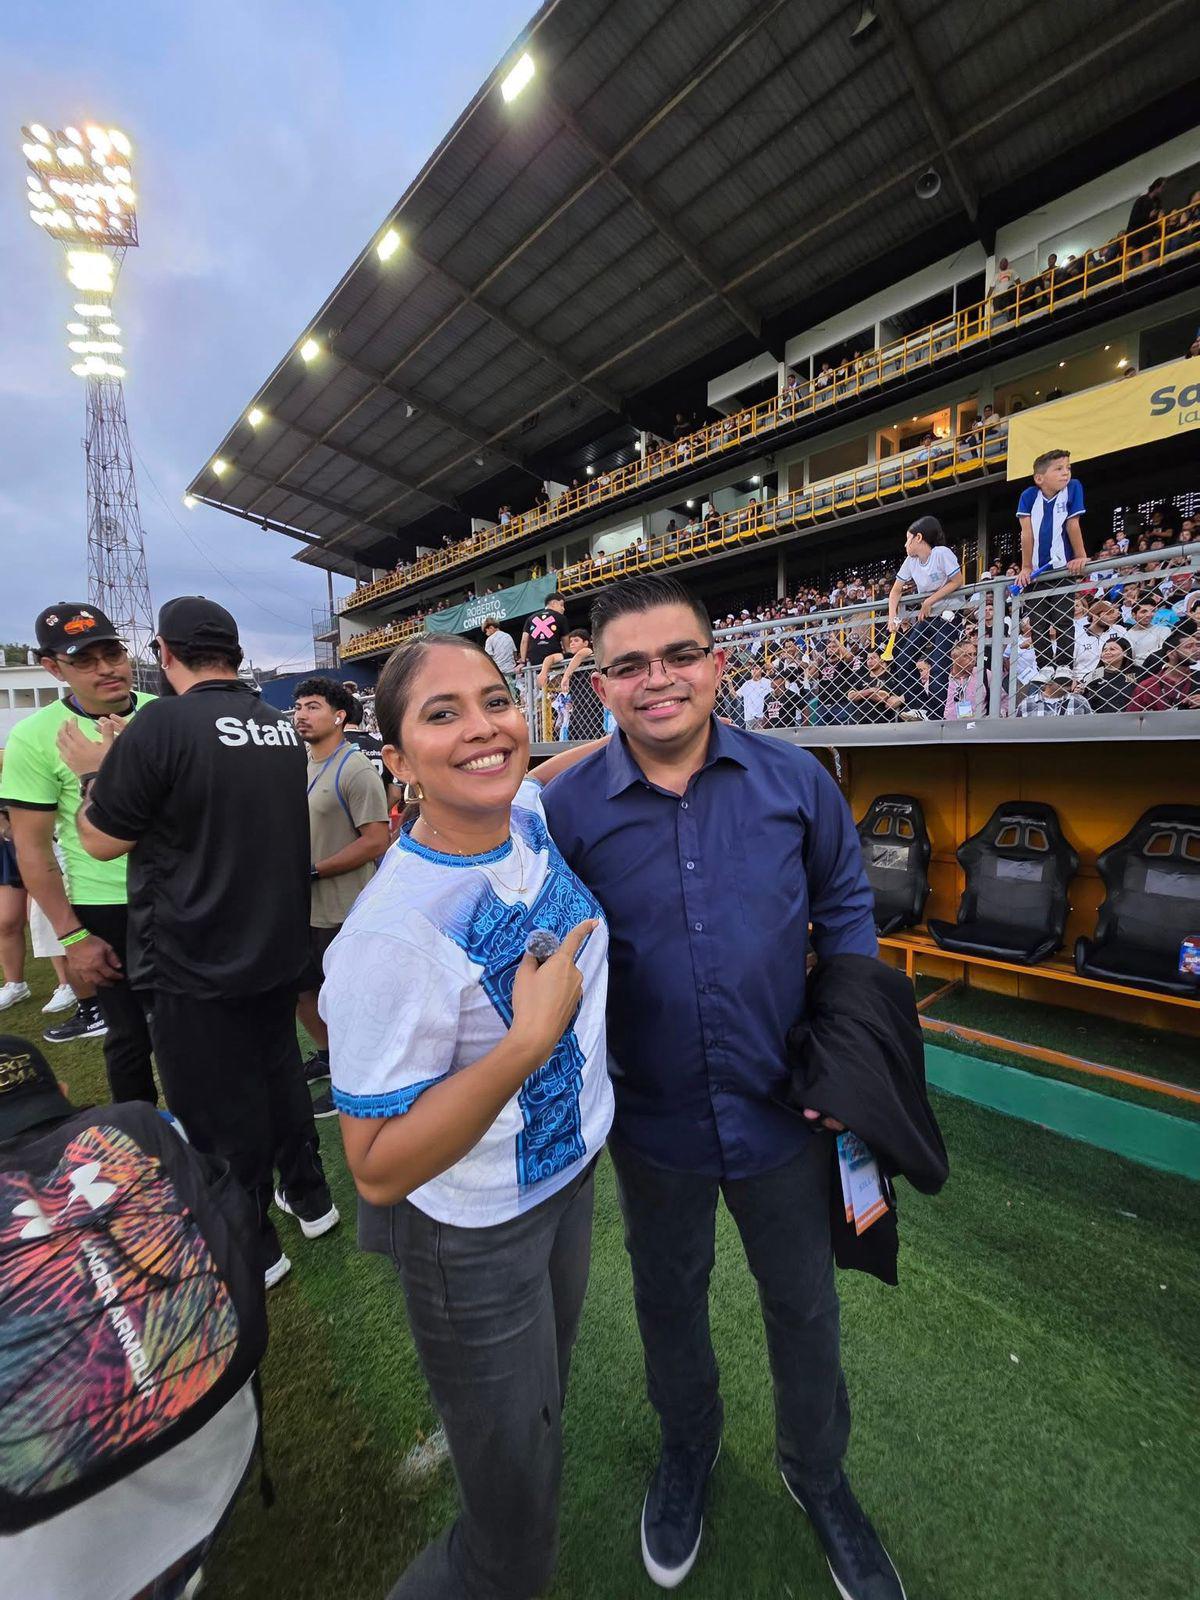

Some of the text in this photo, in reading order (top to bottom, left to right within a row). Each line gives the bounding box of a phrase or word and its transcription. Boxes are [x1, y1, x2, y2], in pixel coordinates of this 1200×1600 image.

[466, 599, 501, 618] ROBERTO
[215, 716, 299, 747] Staff
[80, 1239, 156, 1400] UNDER ARMOUR
